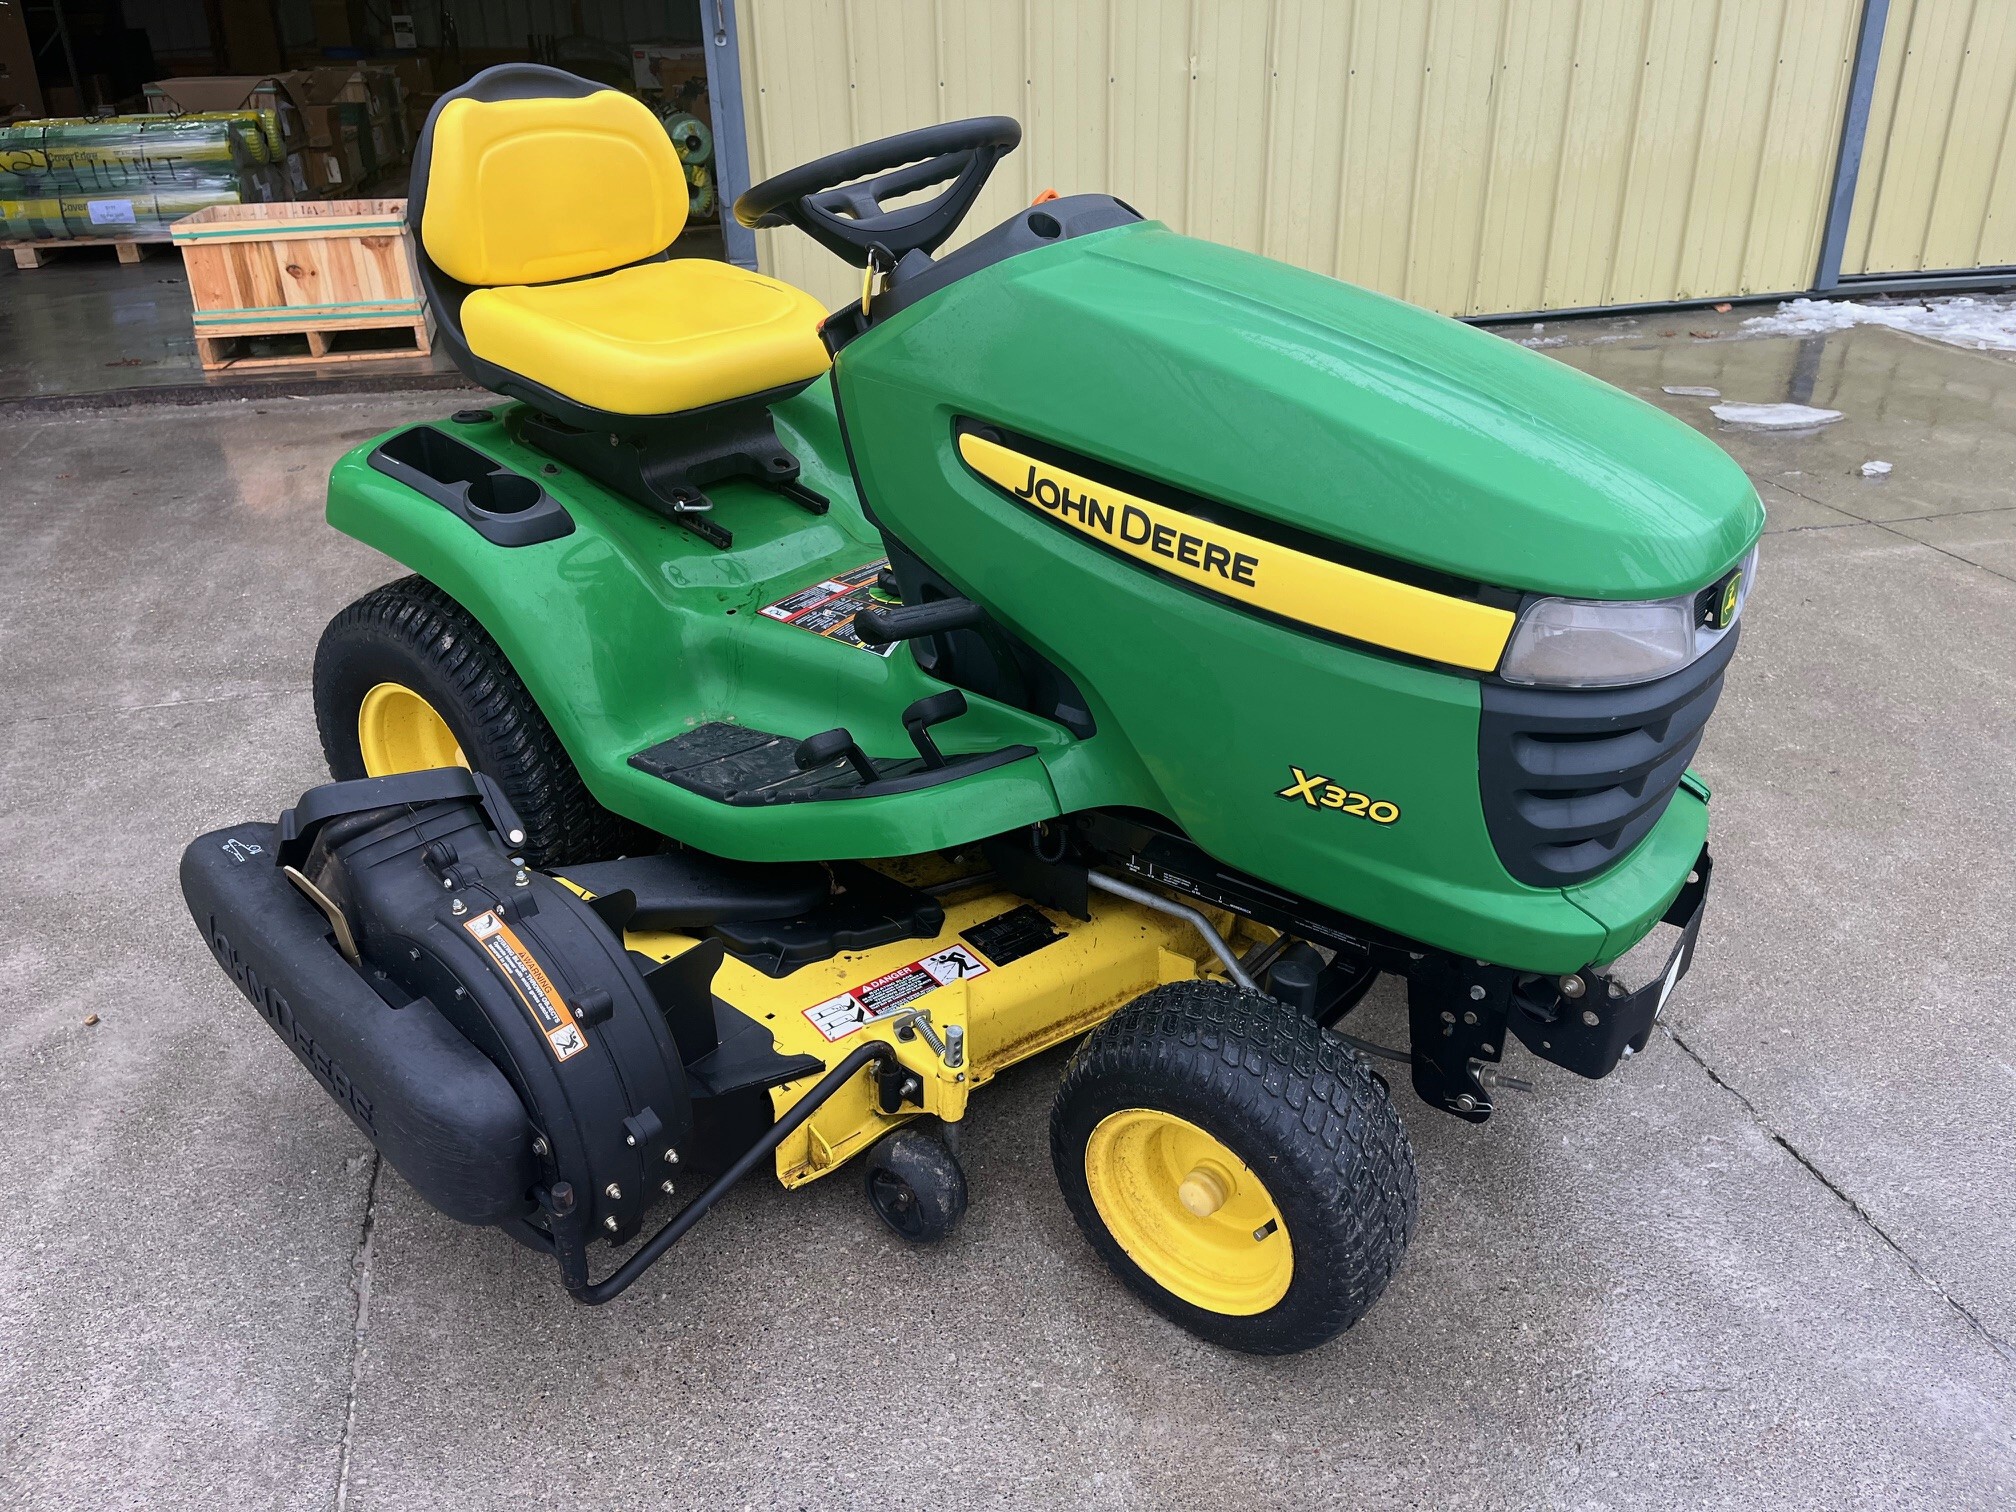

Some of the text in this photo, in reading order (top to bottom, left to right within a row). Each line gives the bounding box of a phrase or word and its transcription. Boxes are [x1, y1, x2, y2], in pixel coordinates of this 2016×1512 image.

[61, 203, 89, 213] Cover
[1015, 466, 1259, 588] JOHN DEERE
[1276, 766, 1401, 824] X320
[494, 934, 560, 1024] ROTATING BLADE THROWN OBJECTS
[522, 955, 552, 994] WARNING
[869, 966, 912, 988] DANGER
[207, 914, 379, 1137] JOHN DEERE
